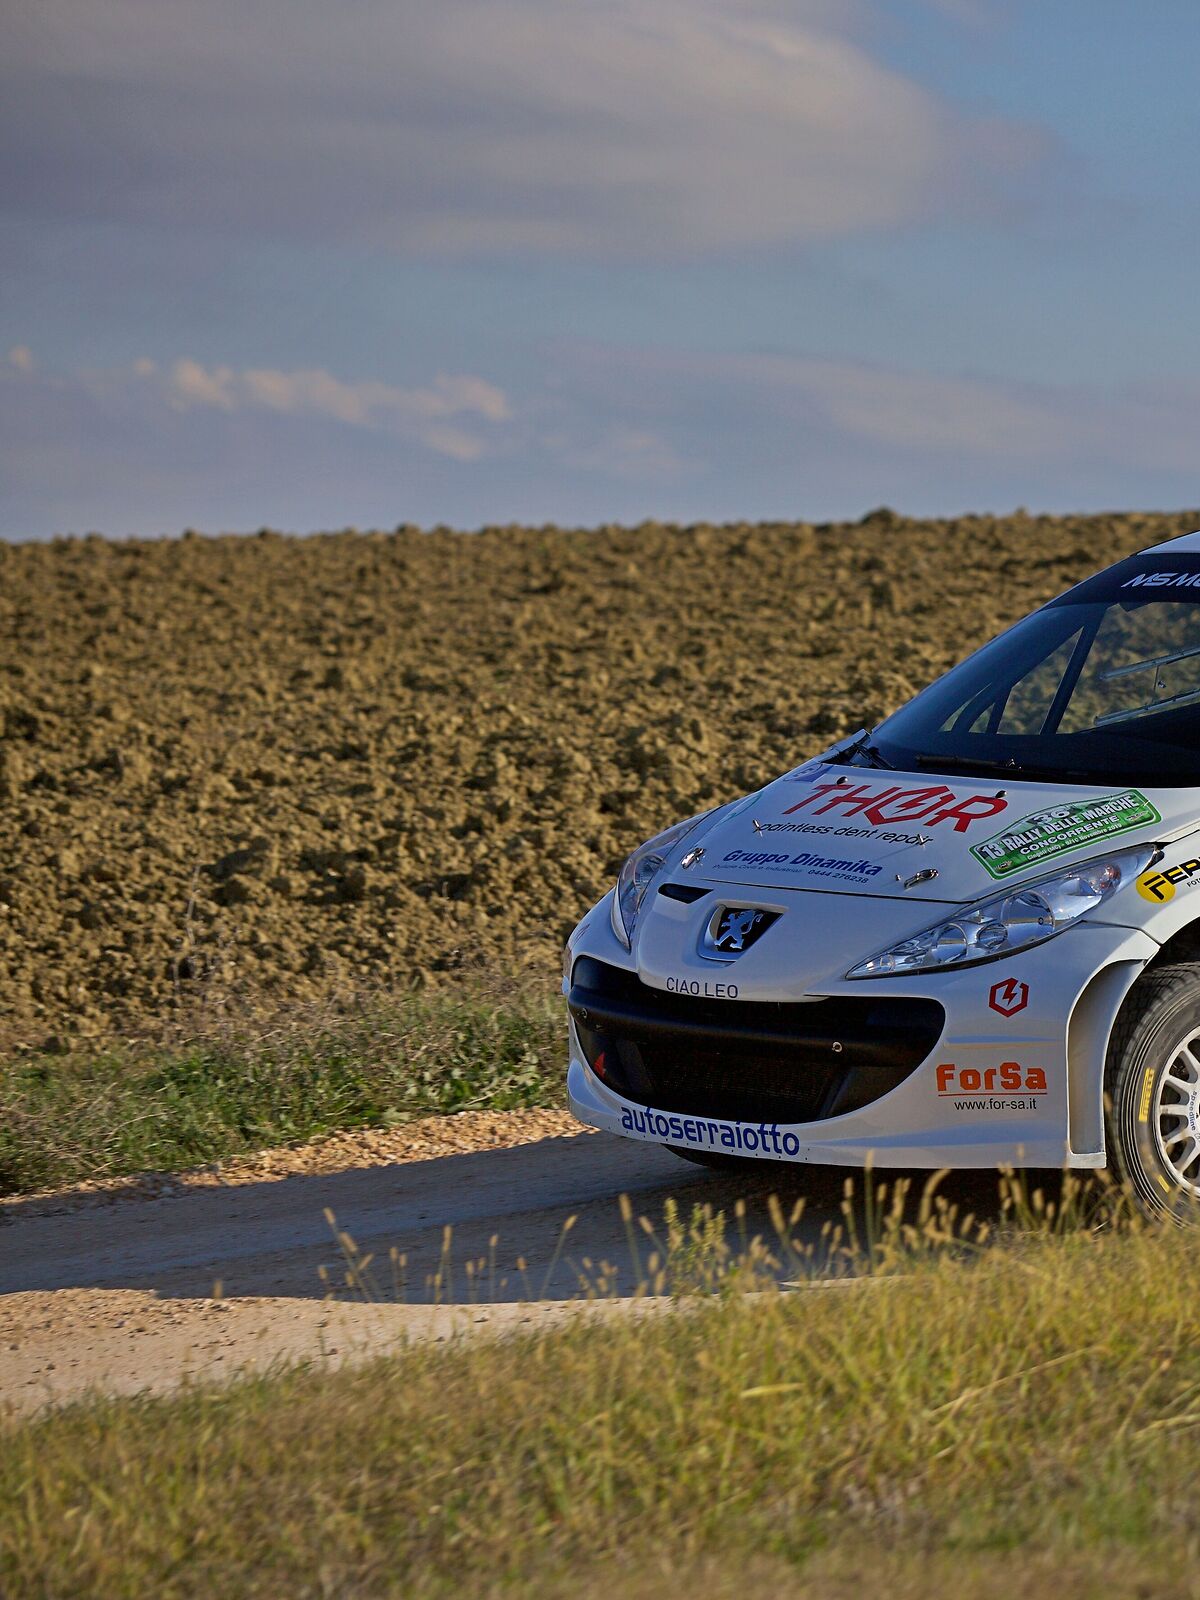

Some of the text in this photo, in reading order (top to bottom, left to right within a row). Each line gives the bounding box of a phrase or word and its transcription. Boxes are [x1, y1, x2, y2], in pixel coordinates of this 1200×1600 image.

[782, 784, 1009, 833] THOR
[1033, 807, 1071, 824] 36
[834, 825, 879, 839] dent
[1002, 826, 1045, 852] RALLY
[1043, 812, 1084, 836] DELLE
[1083, 794, 1140, 825] MARCHE
[1020, 814, 1121, 856] CONCORRENTE
[723, 849, 883, 876] Gruppo Dinamika
[807, 869, 832, 878] 0444
[666, 977, 739, 999] CIAO LEO
[936, 1062, 1048, 1092] ForSa
[954, 1098, 1037, 1110] www.for-sa.it
[621, 1106, 801, 1156] autoserraiotto
